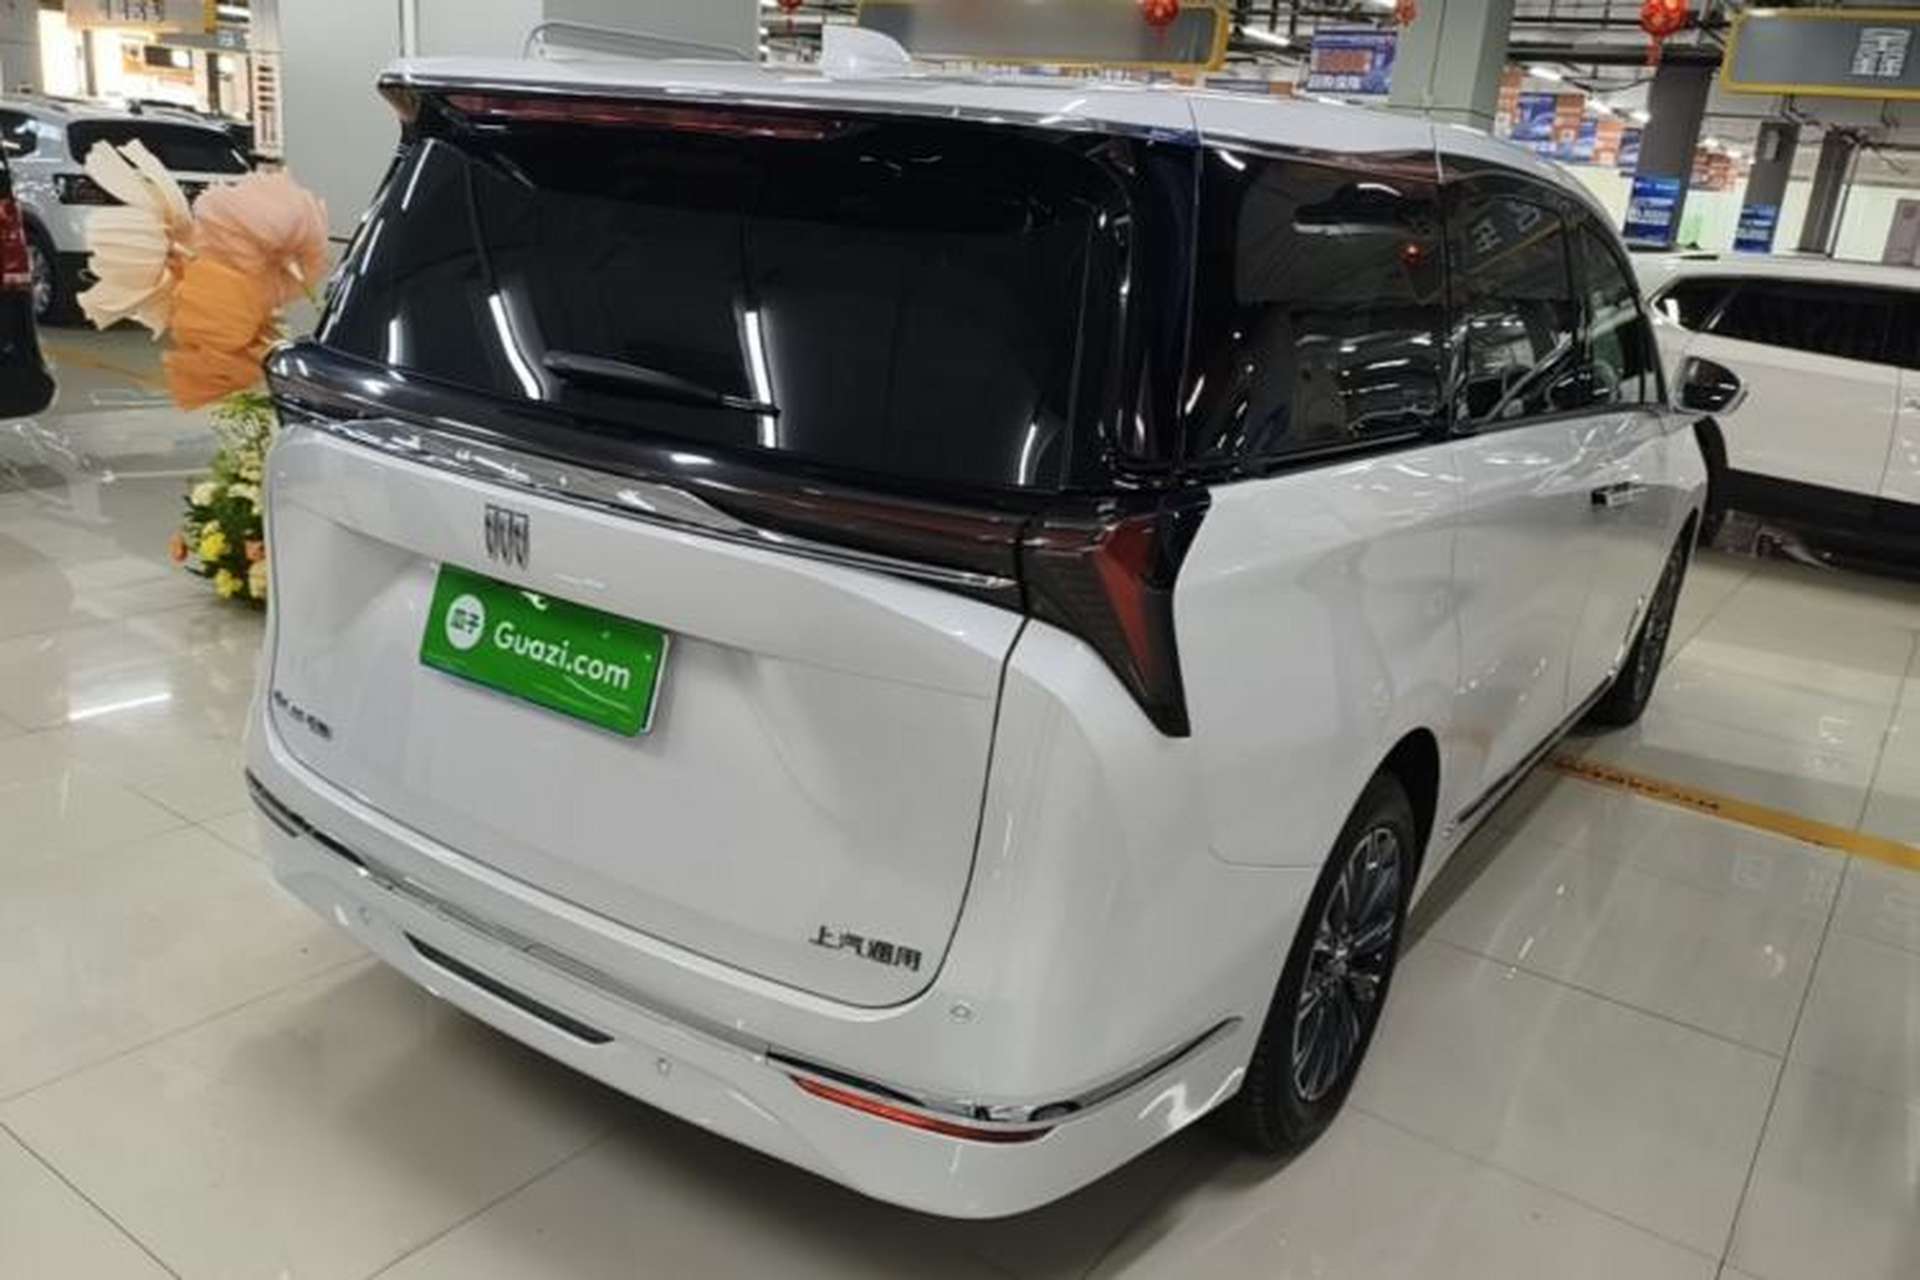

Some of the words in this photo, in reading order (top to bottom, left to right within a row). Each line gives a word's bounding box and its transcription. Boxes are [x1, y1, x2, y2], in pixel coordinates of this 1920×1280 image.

[493, 621, 631, 690] Guazi.com
[808, 925, 922, 972] 上汽通用
